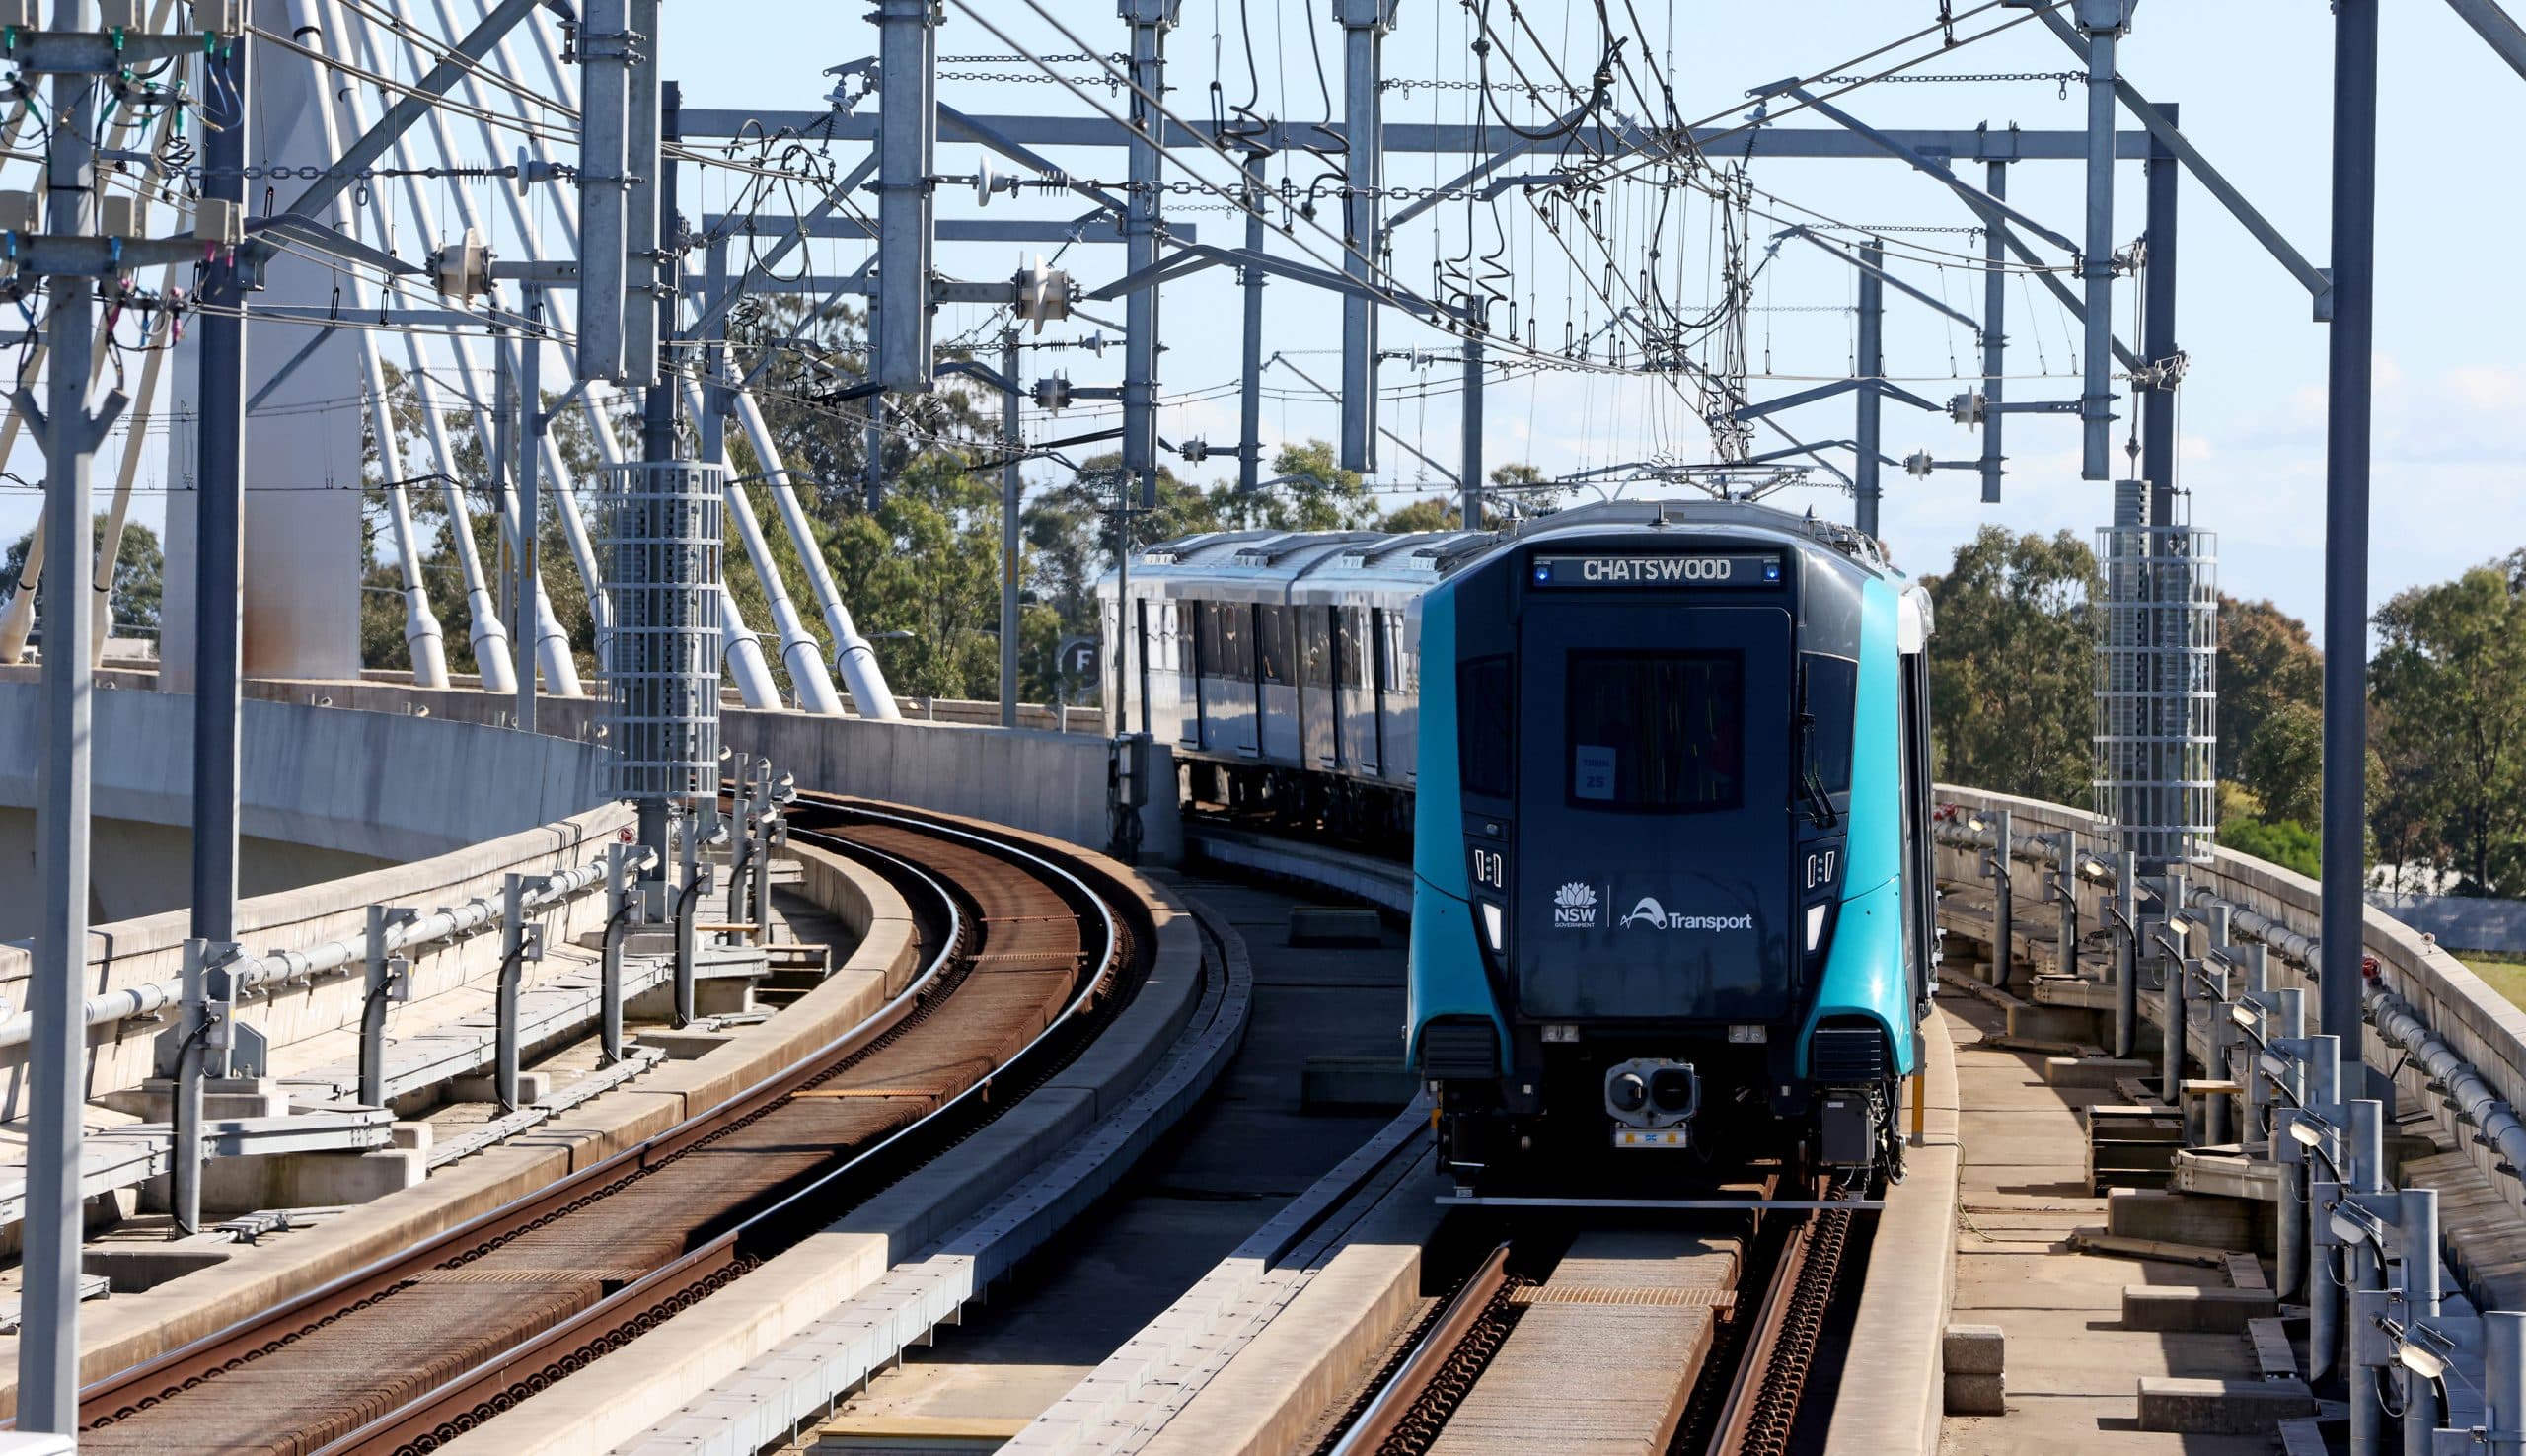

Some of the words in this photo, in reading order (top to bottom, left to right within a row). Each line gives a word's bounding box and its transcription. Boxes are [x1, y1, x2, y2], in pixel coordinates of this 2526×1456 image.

[1583, 559, 1731, 580] CHATSWOOD
[1077, 649, 1093, 672] F
[1555, 908, 1597, 922] NSW
[1668, 912, 1752, 932] Transport
